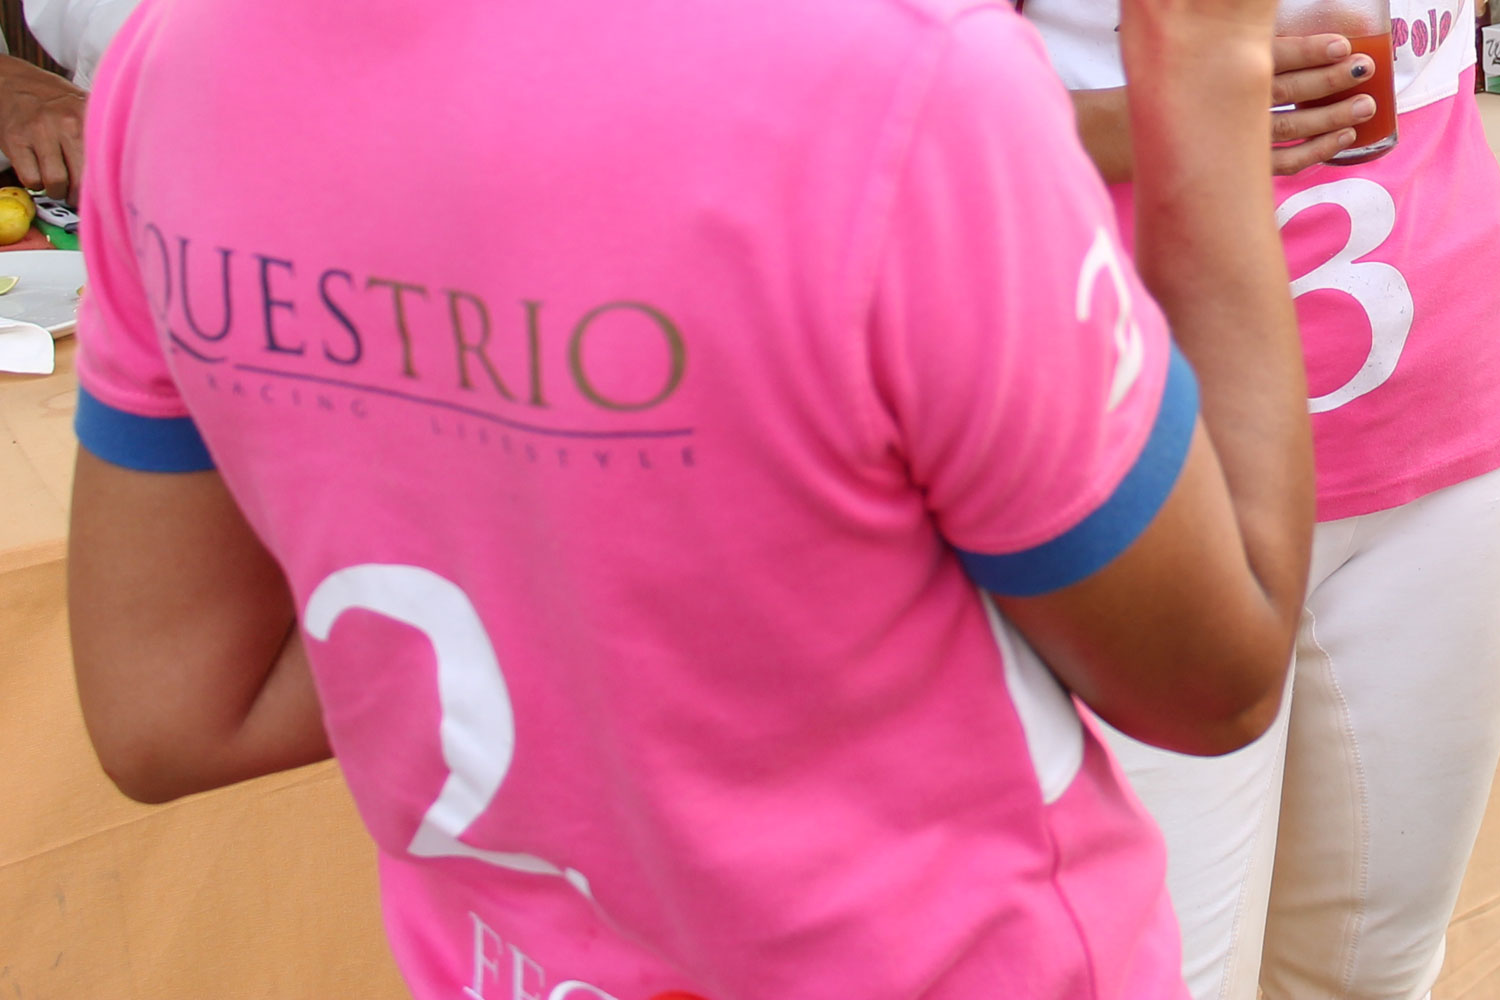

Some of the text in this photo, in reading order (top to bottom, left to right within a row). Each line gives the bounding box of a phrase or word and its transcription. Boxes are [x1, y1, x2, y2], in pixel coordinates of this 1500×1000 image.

[128, 203, 687, 412] QUESTRIO
[1276, 177, 1415, 414] 3
[304, 563, 602, 900] 2
